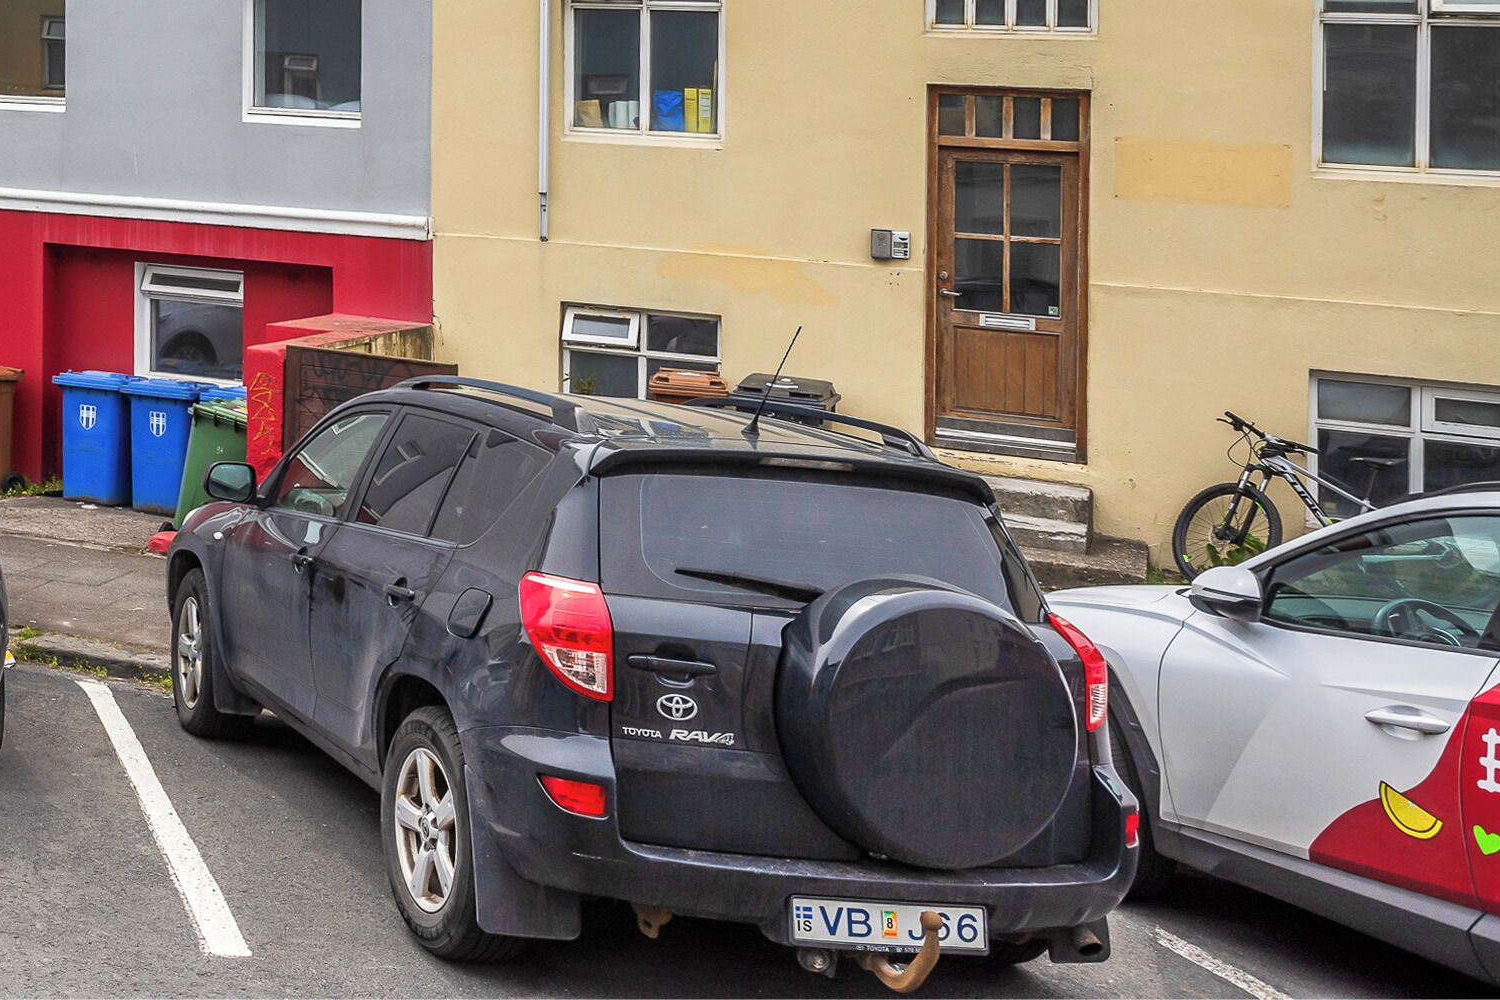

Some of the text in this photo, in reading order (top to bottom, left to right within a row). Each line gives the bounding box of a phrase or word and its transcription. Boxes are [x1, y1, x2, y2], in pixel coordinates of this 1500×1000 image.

[621, 726, 735, 746] TOYOTA RAV4
[797, 919, 813, 932] IS
[818, 905, 873, 938] VB
[886, 917, 894, 930] 8
[866, 945, 890, 953] TOYOTA
